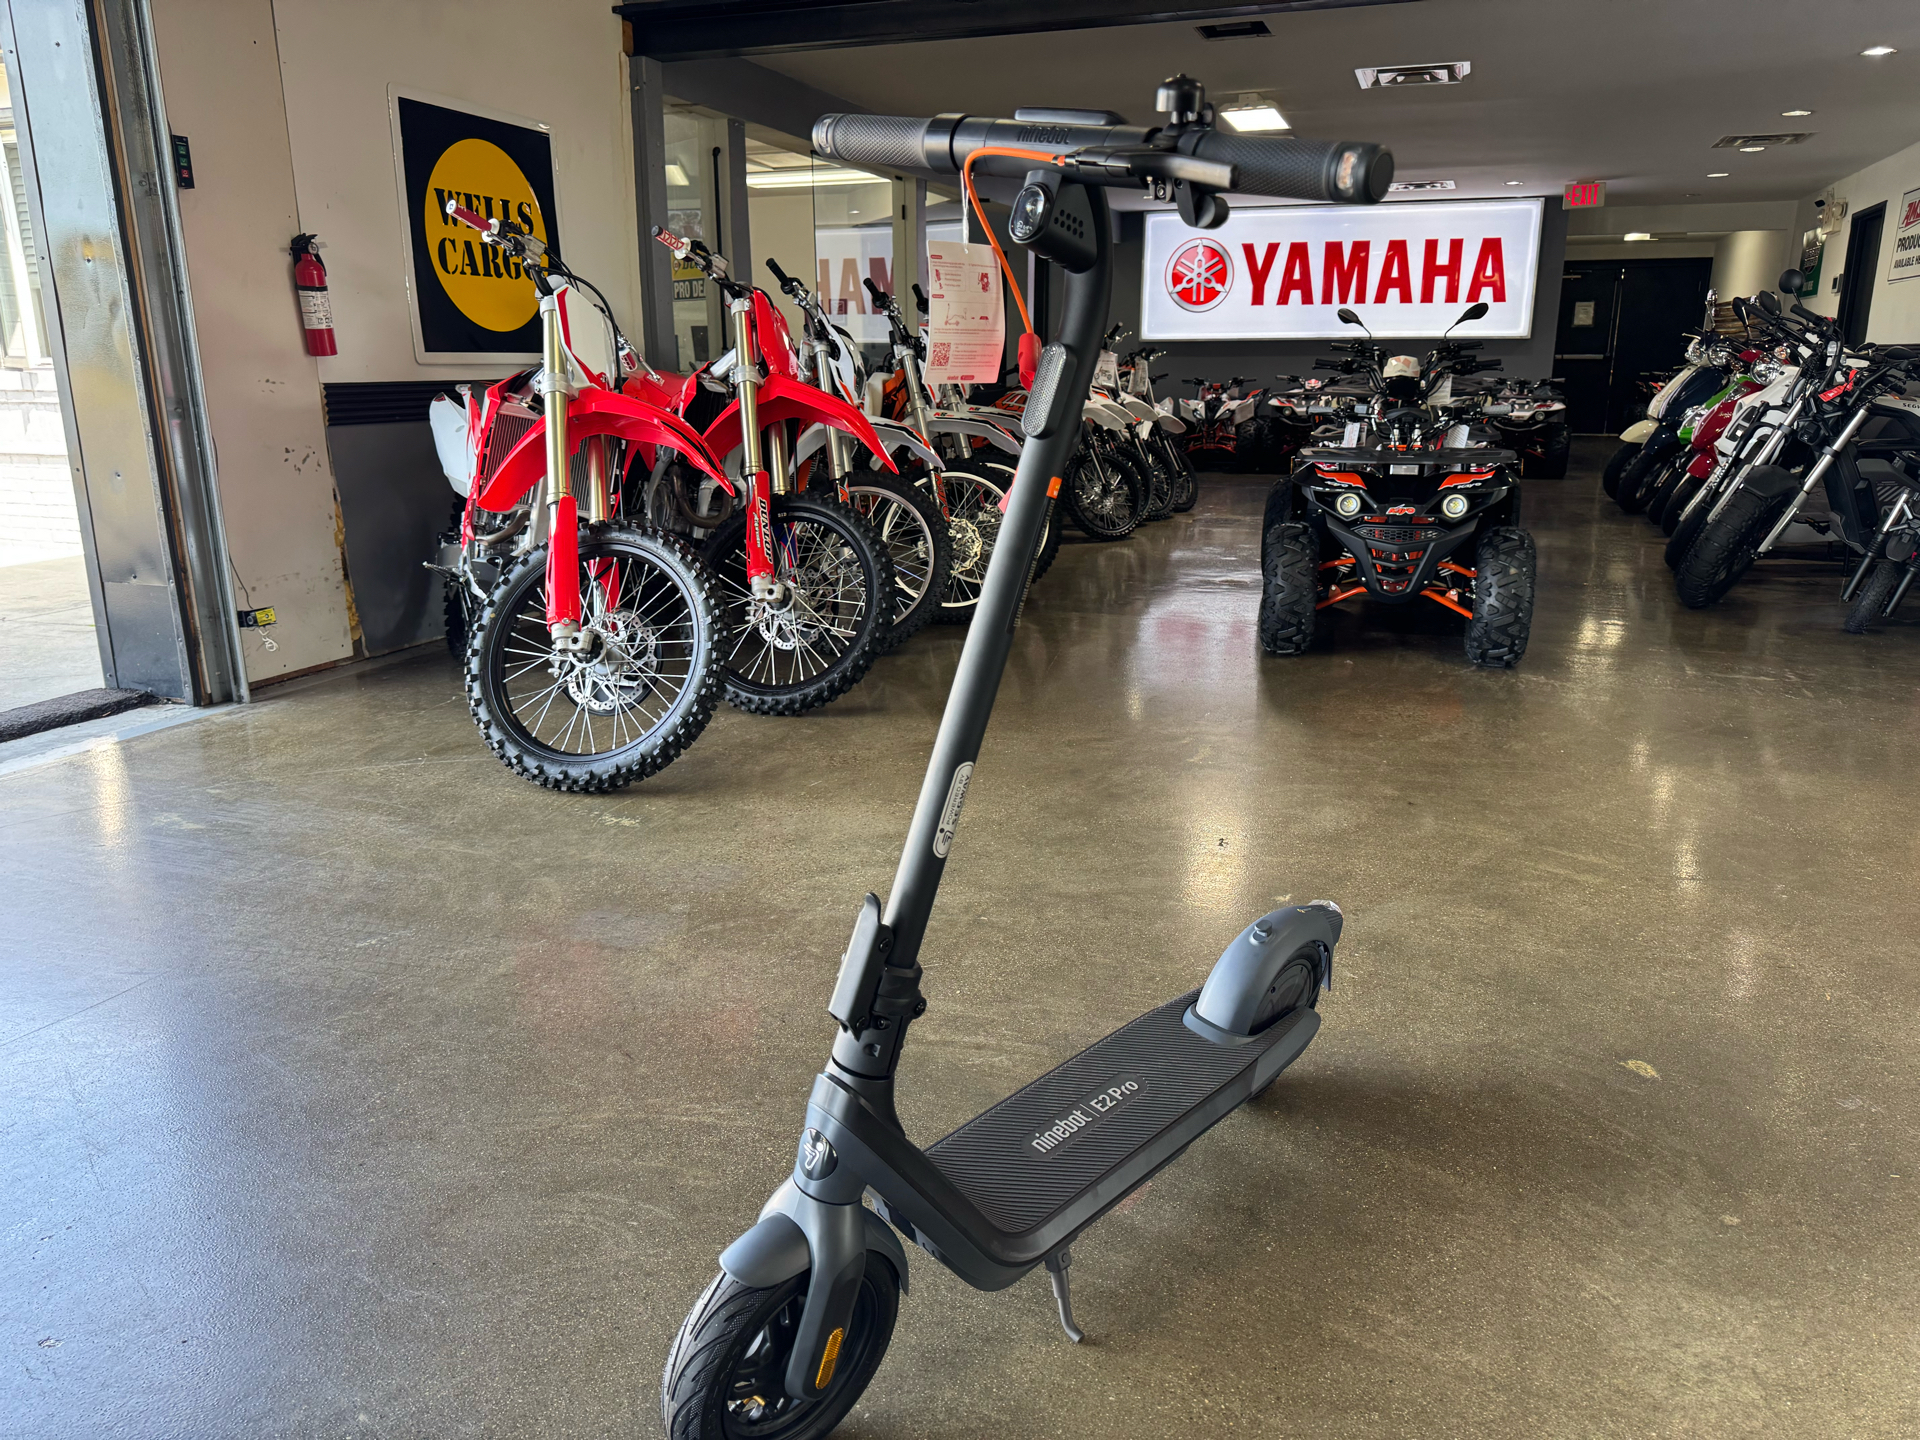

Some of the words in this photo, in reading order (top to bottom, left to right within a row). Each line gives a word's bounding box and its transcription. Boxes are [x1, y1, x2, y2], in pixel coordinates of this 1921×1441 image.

[1017, 124, 1073, 145] ninebot
[1571, 184, 1600, 206] EXIT
[674, 281, 690, 298] PRO
[692, 280, 705, 297] DE
[1241, 237, 1507, 306] YAMAHA
[758, 498, 772, 564] DUNLOP
[946, 787, 961, 825] POWERED
[958, 773, 965, 785] BY
[1031, 1109, 1093, 1153] ninebot
[1089, 1094, 1118, 1112] E2
[1106, 1081, 1139, 1101] Pro
